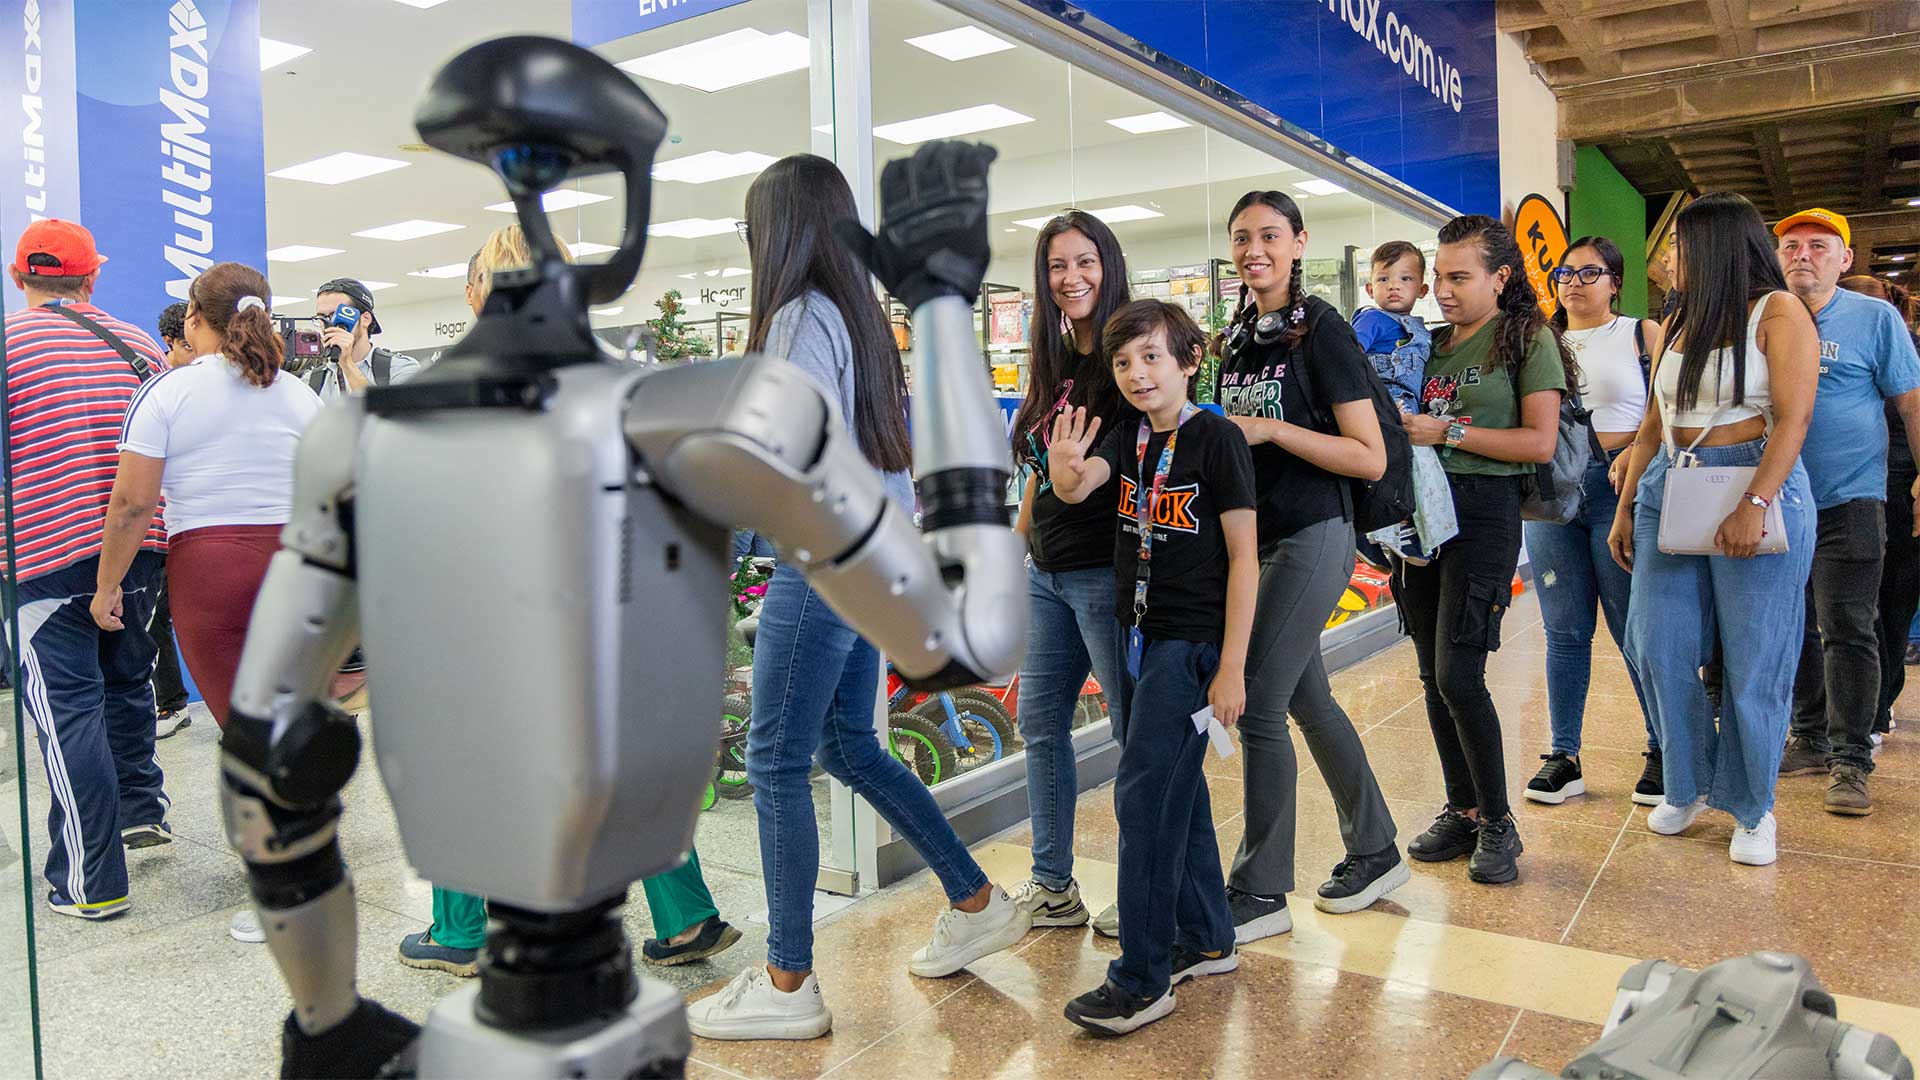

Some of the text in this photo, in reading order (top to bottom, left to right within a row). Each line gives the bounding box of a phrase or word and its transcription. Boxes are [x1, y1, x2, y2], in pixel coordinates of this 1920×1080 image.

[639, 0, 688, 17] EN
[22, 15, 47, 222] ltiMax
[159, 25, 215, 301] MultiMax
[701, 287, 746, 307] Hogar
[435, 320, 467, 339] Hogar
